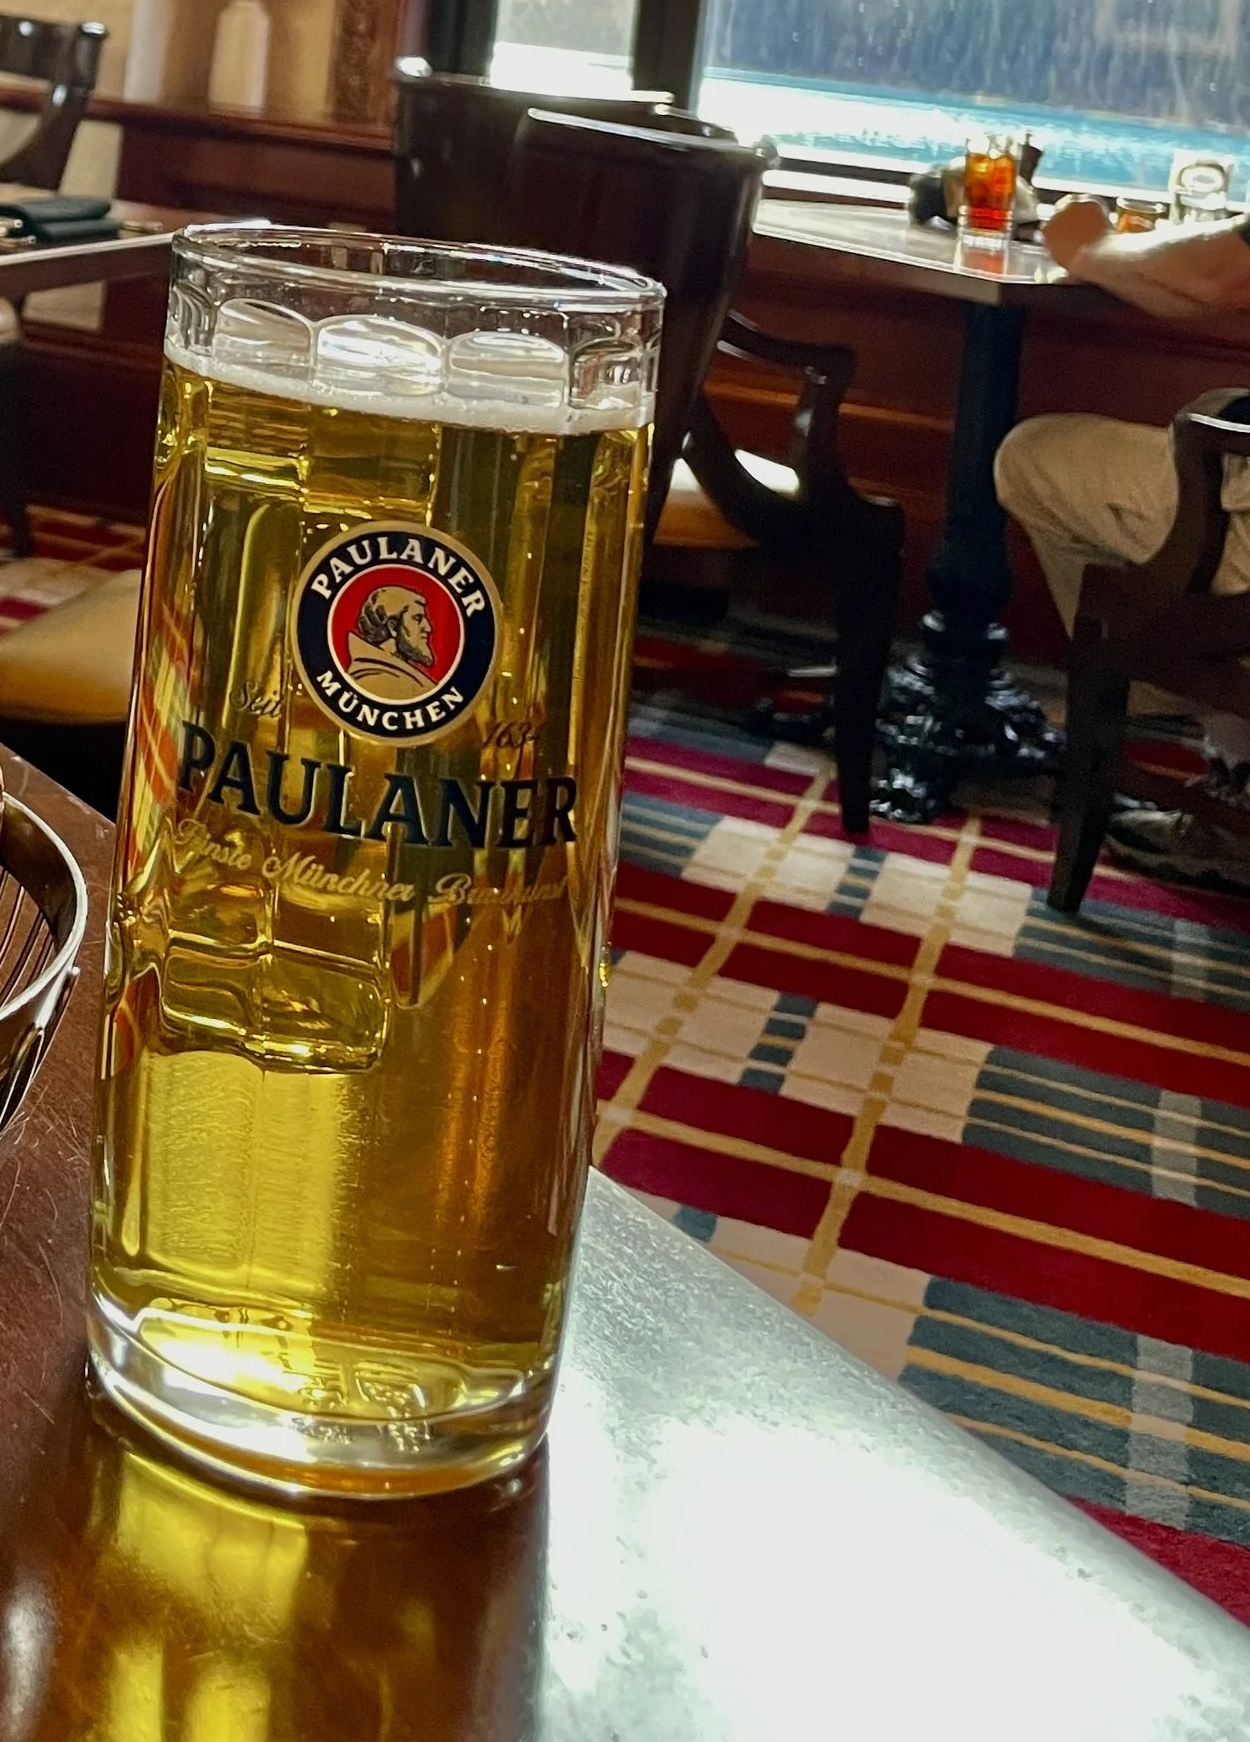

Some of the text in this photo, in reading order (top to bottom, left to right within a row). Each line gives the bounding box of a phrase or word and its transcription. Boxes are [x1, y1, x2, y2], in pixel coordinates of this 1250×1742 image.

[311, 536, 486, 617] PAULANER
[317, 670, 464, 731] MÜNCHEN
[179, 722, 577, 848] PAULANER
[262, 852, 415, 901] Münchner
